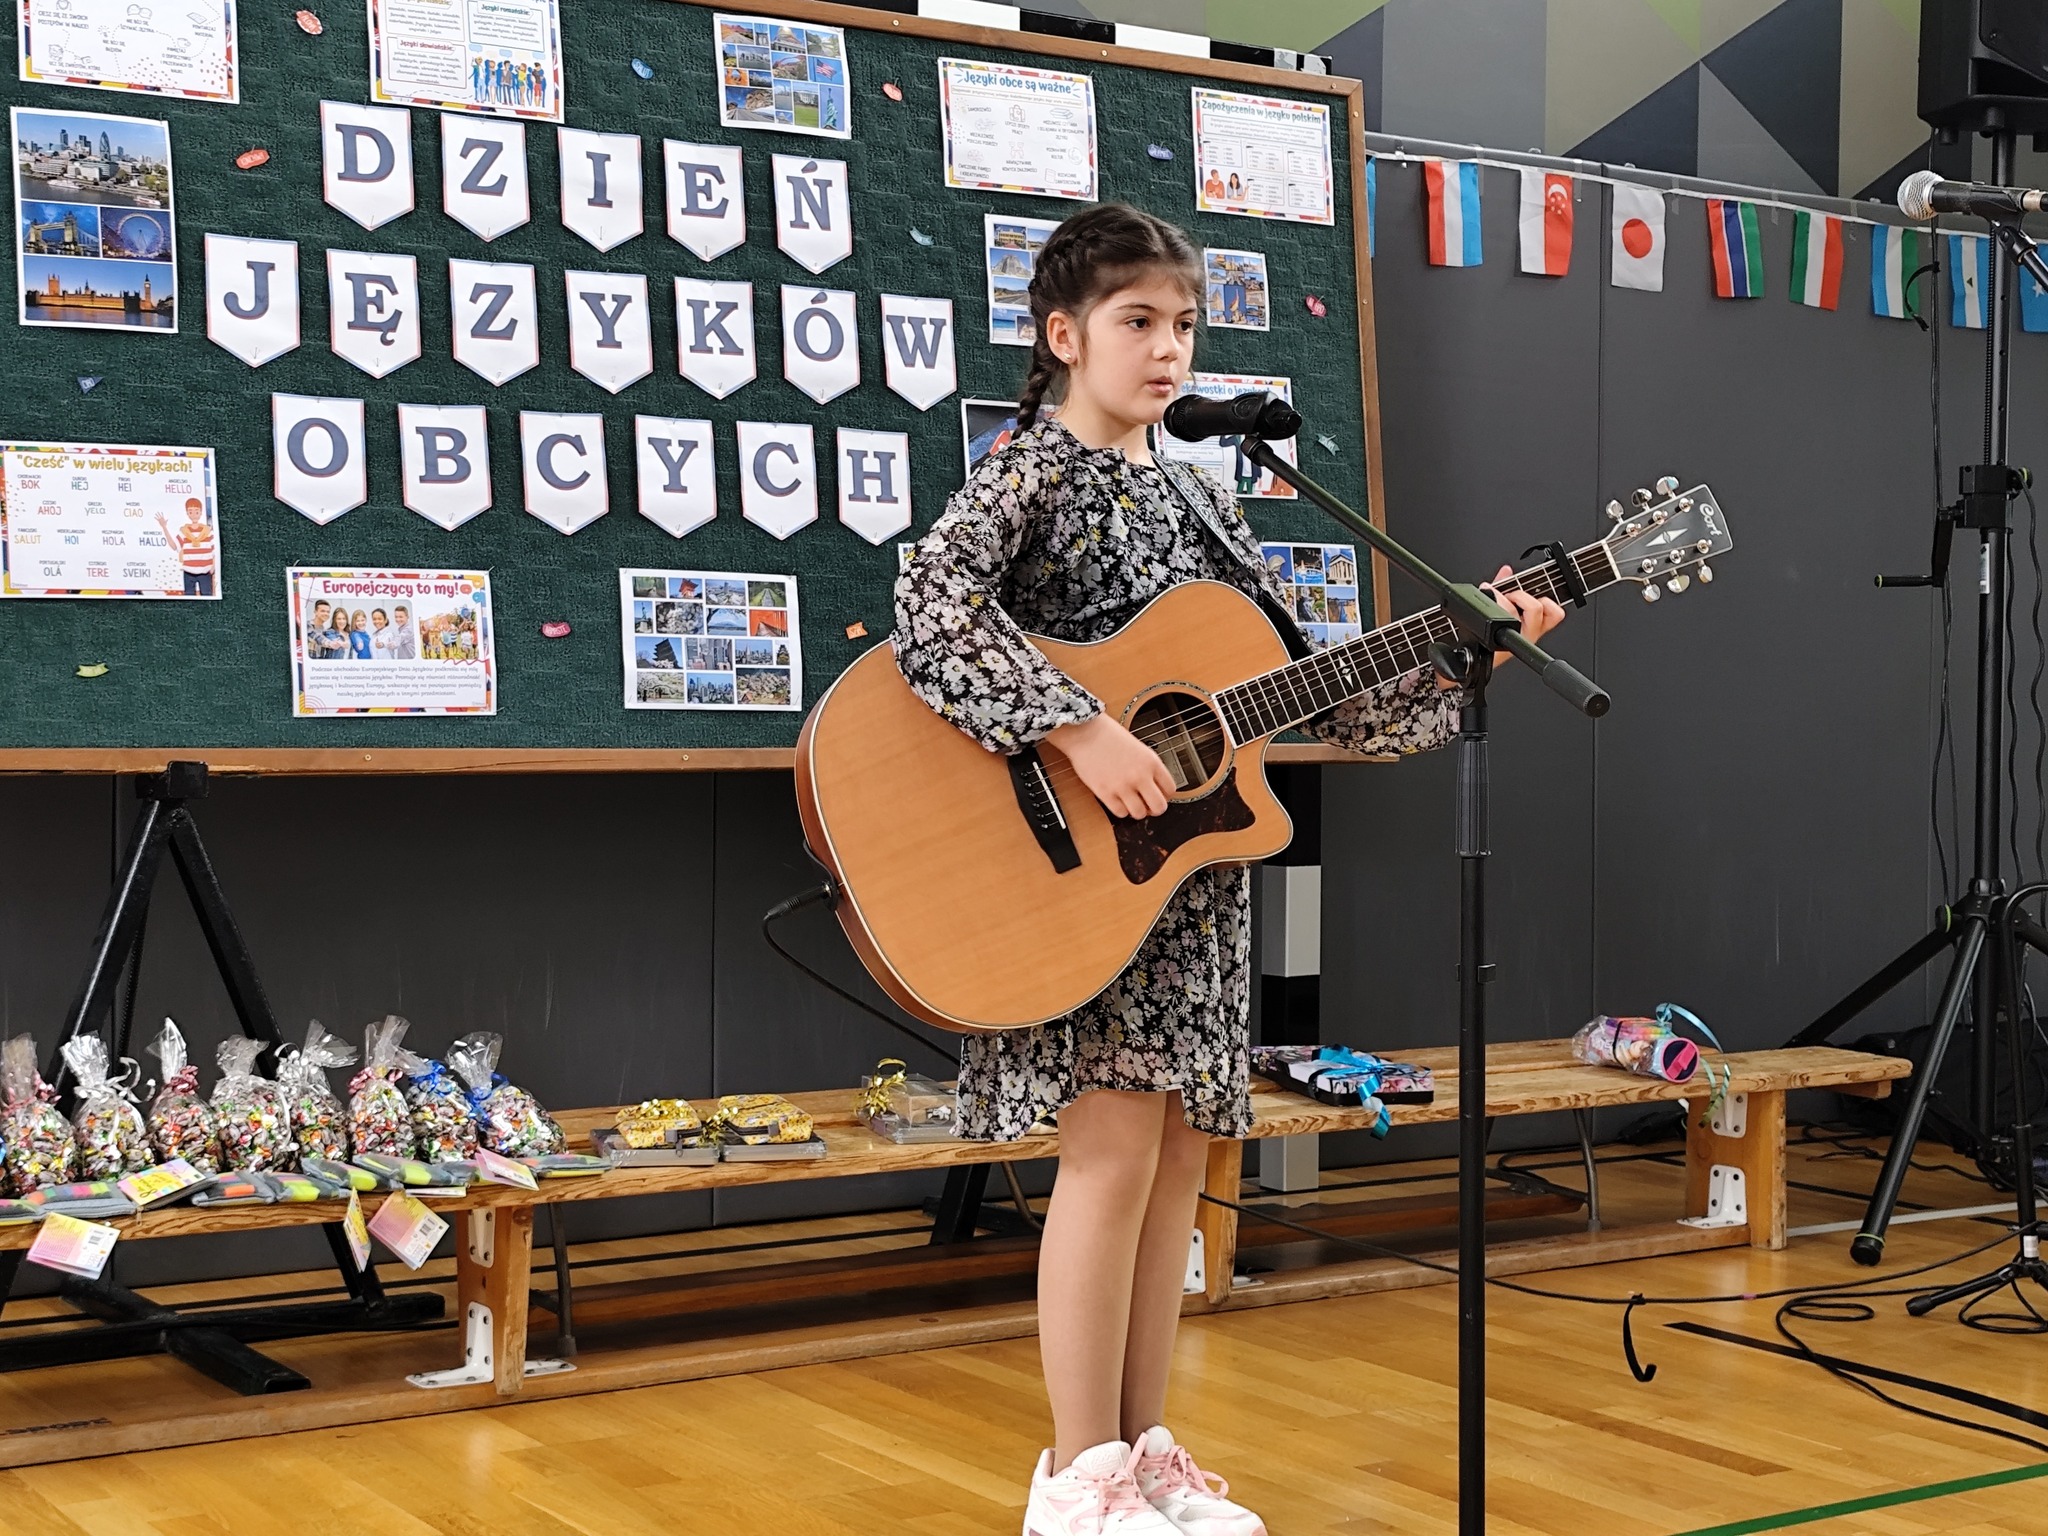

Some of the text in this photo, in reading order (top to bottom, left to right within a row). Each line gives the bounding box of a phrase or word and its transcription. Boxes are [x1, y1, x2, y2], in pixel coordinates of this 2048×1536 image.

[964, 71, 1072, 94] Języki obce są ważne
[1202, 100, 1256, 115] Zapożyczenia
[1265, 108, 1291, 121] języku
[1292, 113, 1321, 124] polskim
[335, 122, 832, 232] DZIEŃ
[223, 260, 946, 369] JĘZYKÓW
[1182, 382, 1226, 395] ekawostki
[74, 459, 86, 470] w
[89, 457, 125, 471] wielu
[126, 458, 193, 474] językach!
[287, 417, 897, 505] OBCYCH
[21, 480, 40, 489] BOK
[71, 481, 89, 491] HEJ
[118, 483, 132, 492] HEI
[165, 484, 192, 494] HELLO
[37, 506, 62, 516] AHOJ
[123, 508, 143, 518] CIAO
[1700, 503, 1723, 536] Cort
[14, 535, 41, 544] SALUT
[64, 535, 79, 545] HOI
[102, 536, 125, 546] HOLA
[139, 537, 167, 547] HALLO
[43, 565, 62, 577] OLÁ
[87, 567, 109, 577] TERE
[123, 568, 151, 578] SVEIKI
[322, 580, 459, 598] Europejczycy to my!
